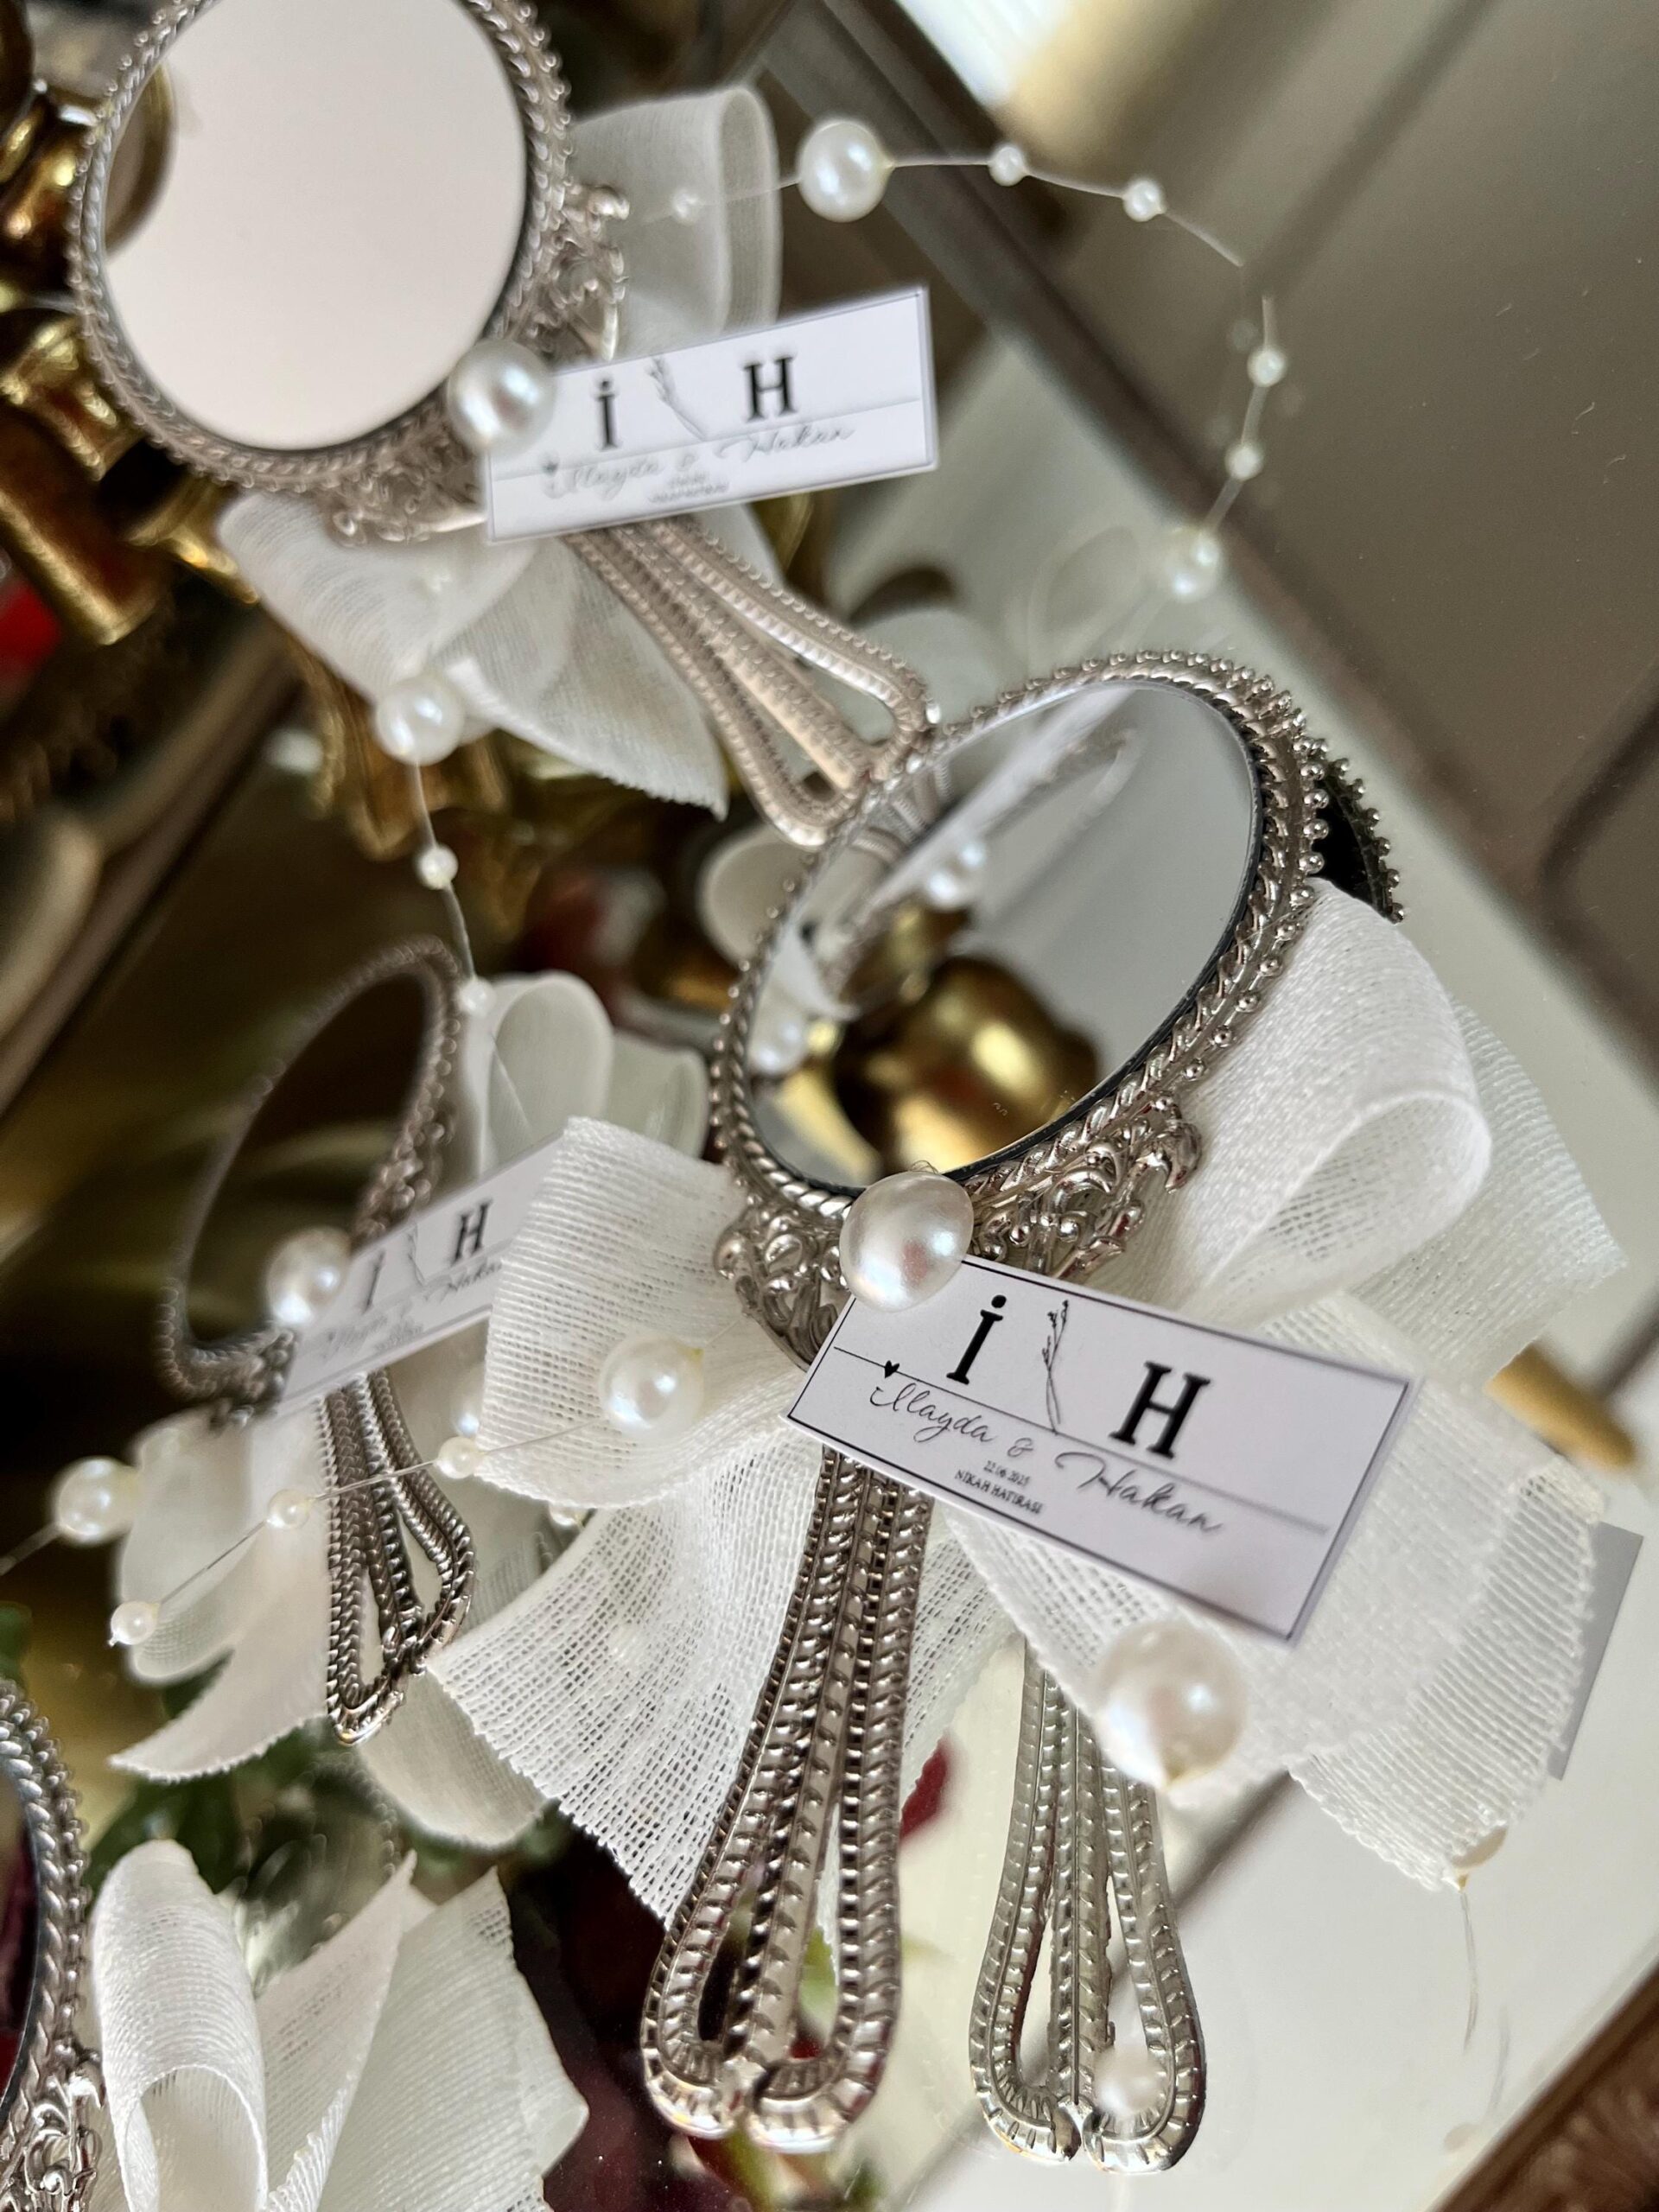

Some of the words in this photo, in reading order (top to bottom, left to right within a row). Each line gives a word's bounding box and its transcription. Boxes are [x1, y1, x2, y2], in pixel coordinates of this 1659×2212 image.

[742, 354, 799, 423] H
[451, 1198, 493, 1268] H
[1109, 1360, 1211, 1459] H
[1054, 1451, 1224, 1533] Hakan
